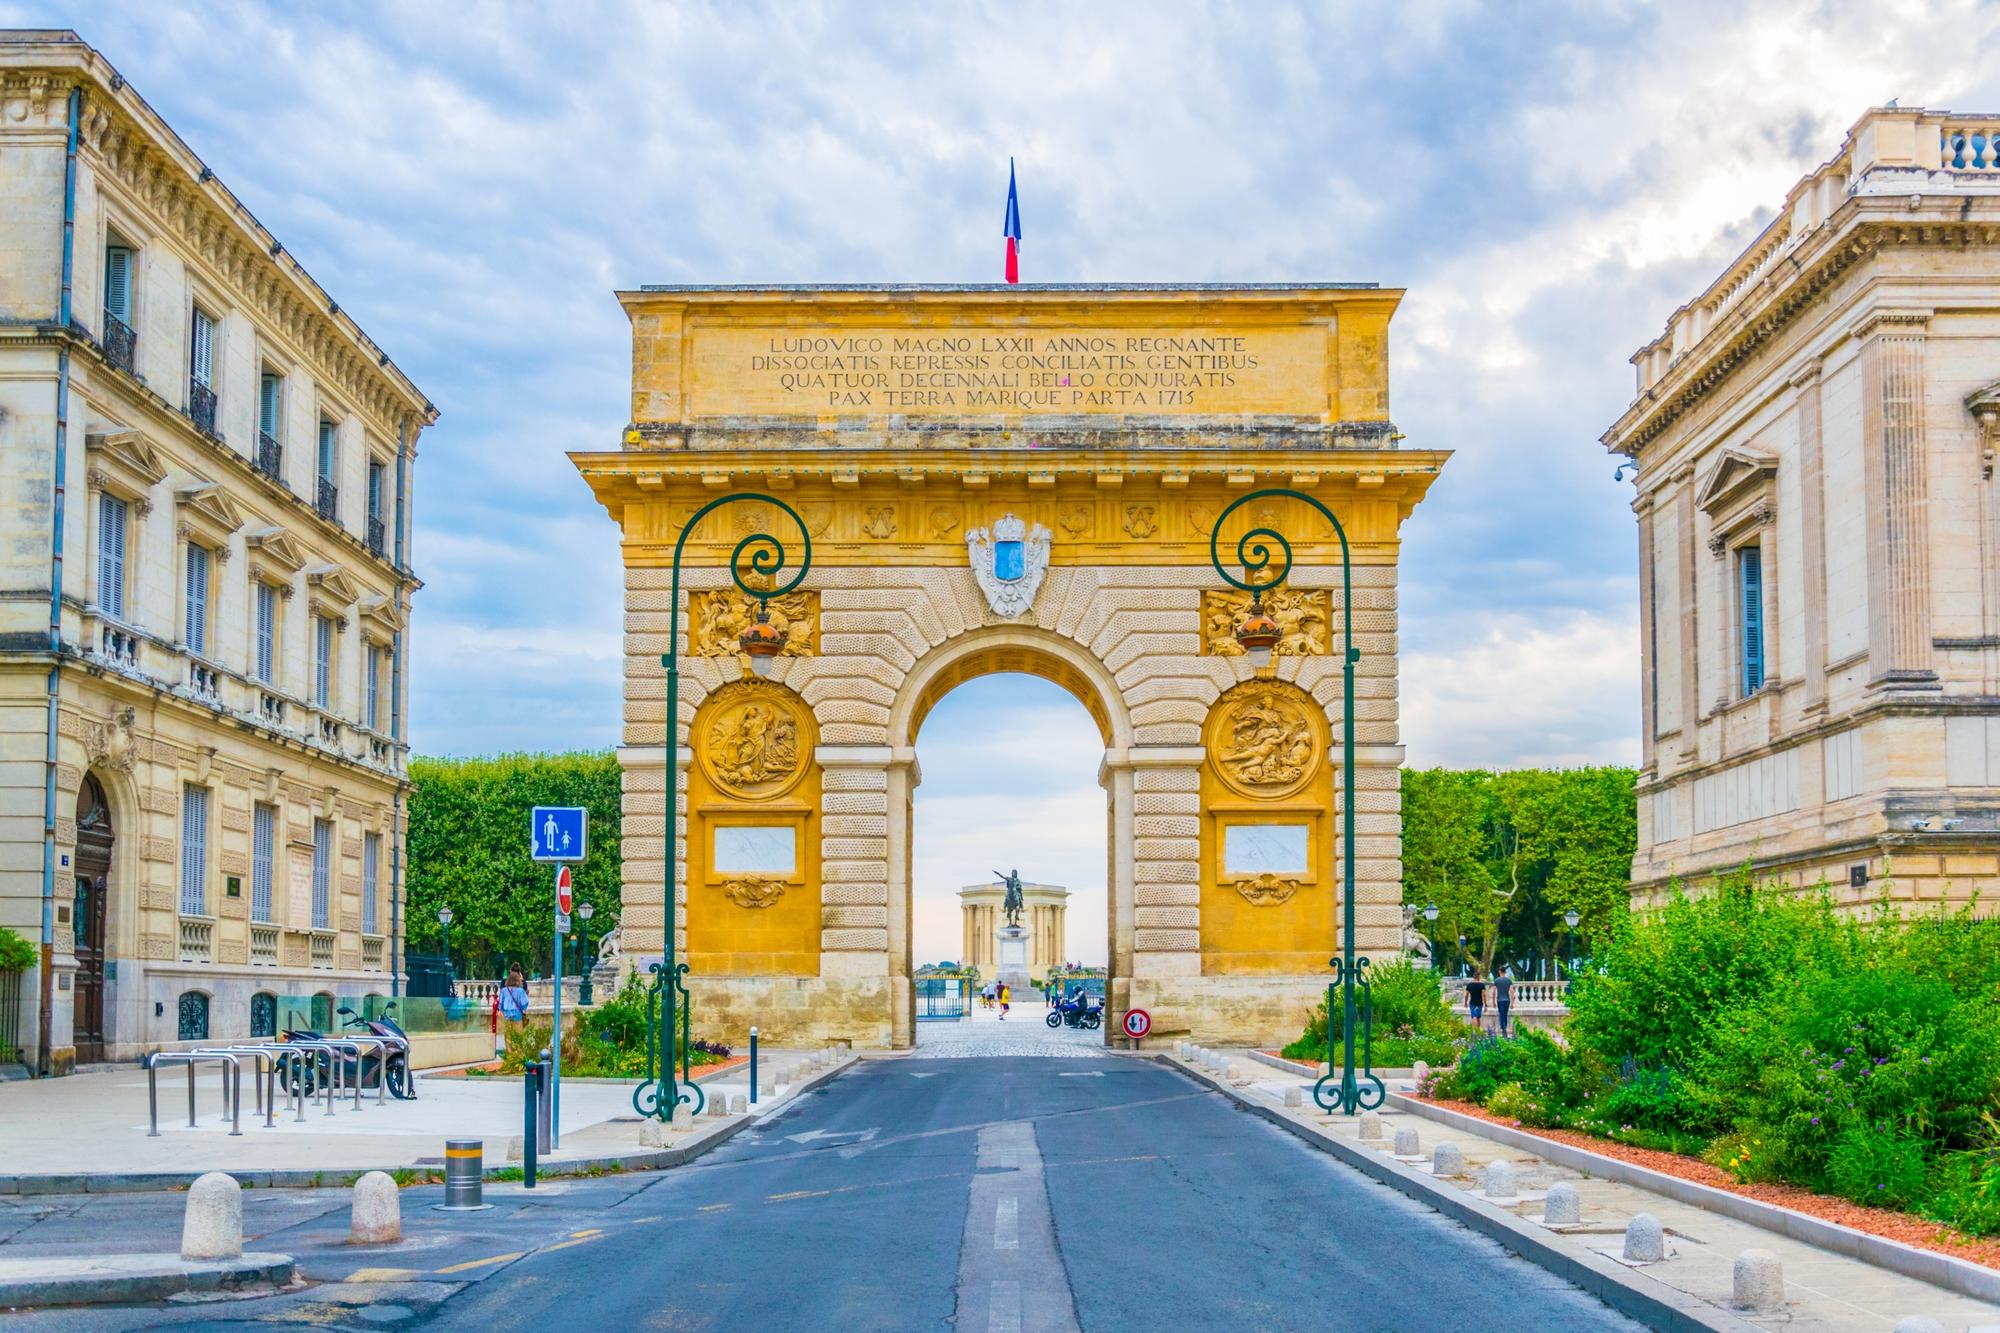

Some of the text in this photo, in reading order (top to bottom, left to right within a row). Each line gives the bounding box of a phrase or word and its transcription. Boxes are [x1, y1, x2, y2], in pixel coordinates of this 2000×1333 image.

[770, 337, 1246, 353] LUDOVICO MAGNO LXXII ANNOS REGNANTE
[751, 354, 1259, 371] DISSOCIATIS REPRESSIS CONCILIATIS GENTIBUS
[780, 372, 1236, 392] QUATUOR DECENNALI BELLO CONJURATIS
[829, 391, 871, 406] PAX
[882, 390, 956, 406] TERRA
[966, 390, 1062, 410] MARIQUE
[1072, 390, 1147, 406] PARTA
